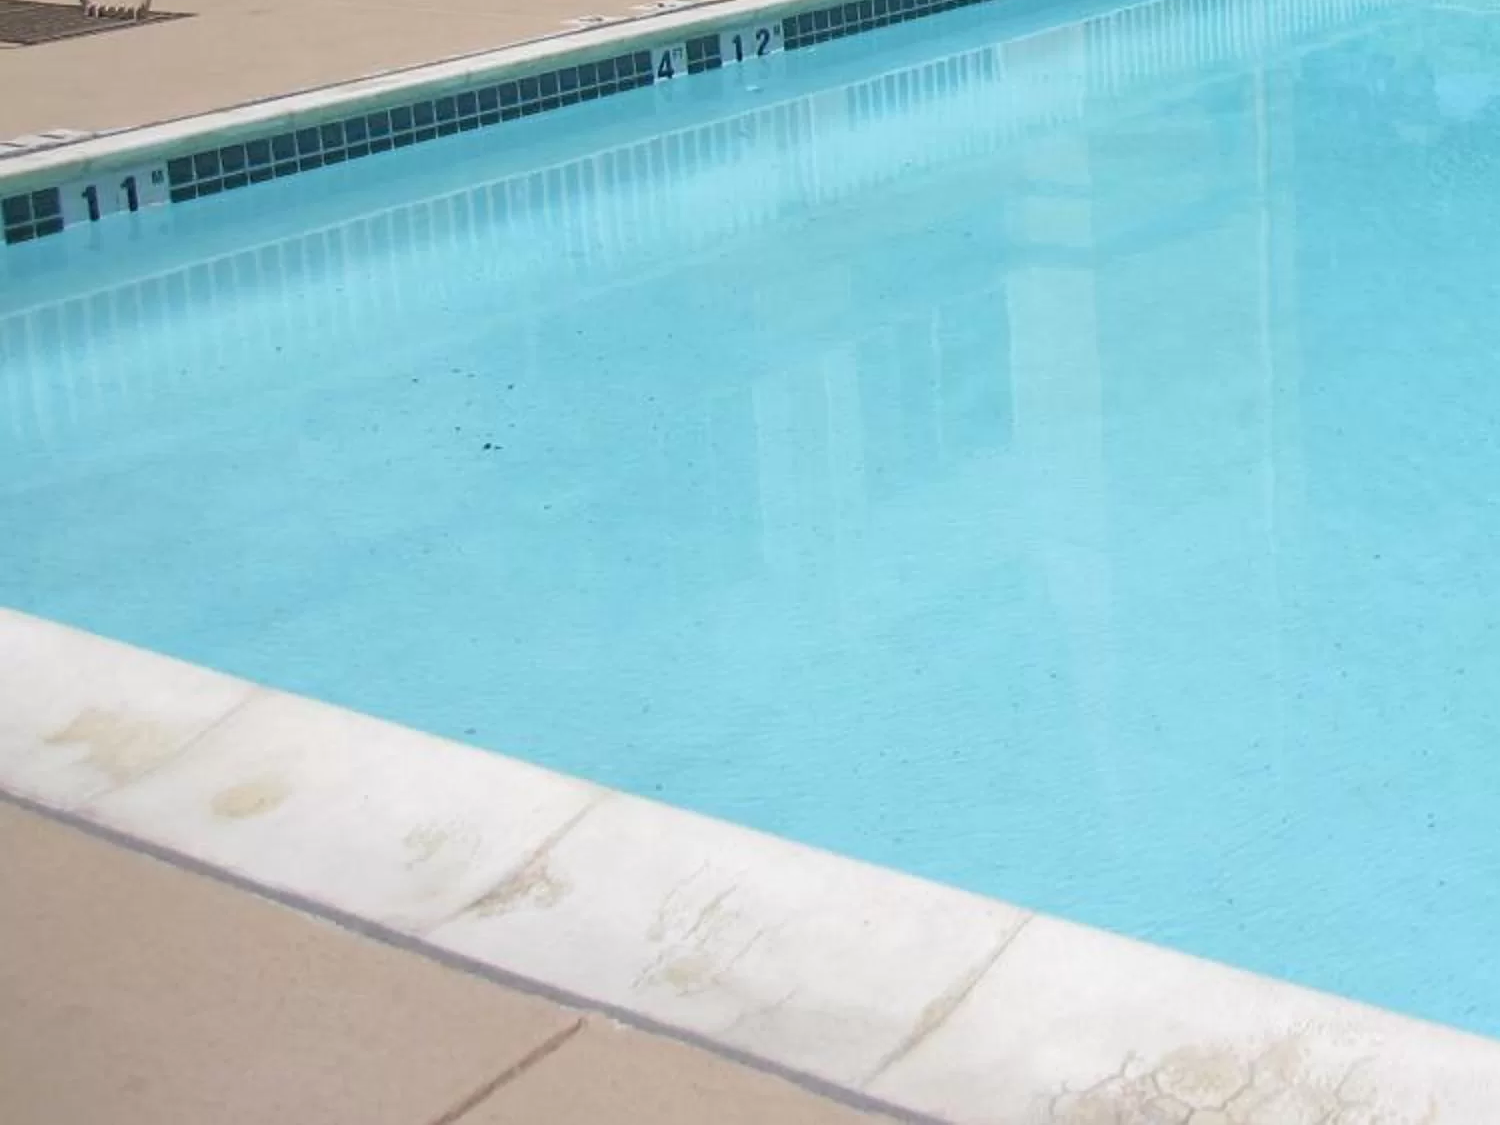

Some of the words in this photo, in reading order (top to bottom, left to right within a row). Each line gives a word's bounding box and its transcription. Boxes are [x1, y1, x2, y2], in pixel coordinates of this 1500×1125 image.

[732, 27, 770, 62] 12
[658, 49, 674, 79] 4
[81, 176, 139, 222] 11
